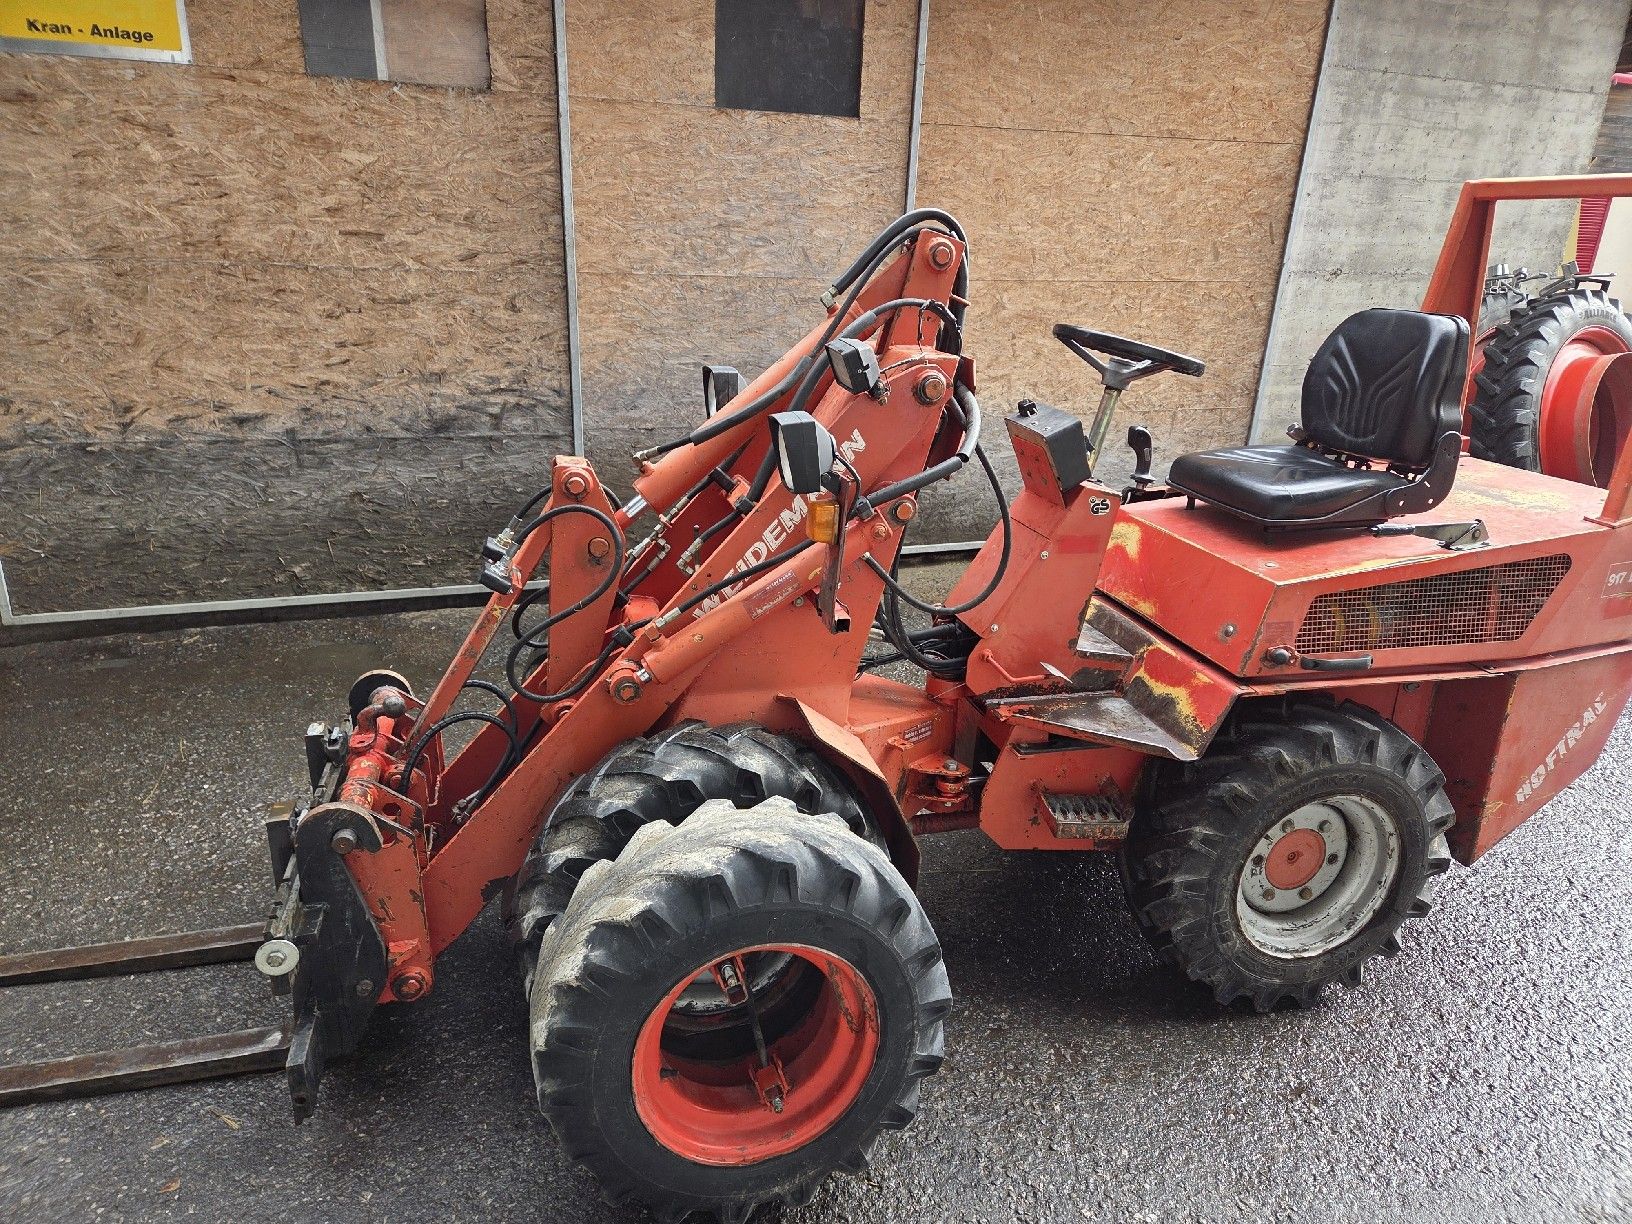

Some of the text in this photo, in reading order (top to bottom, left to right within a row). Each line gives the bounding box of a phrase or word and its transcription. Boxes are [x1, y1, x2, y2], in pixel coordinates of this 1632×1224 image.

[26, 18, 72, 34] Kran
[90, 24, 154, 43] Anlage
[692, 428, 866, 619] WEIDEMN
